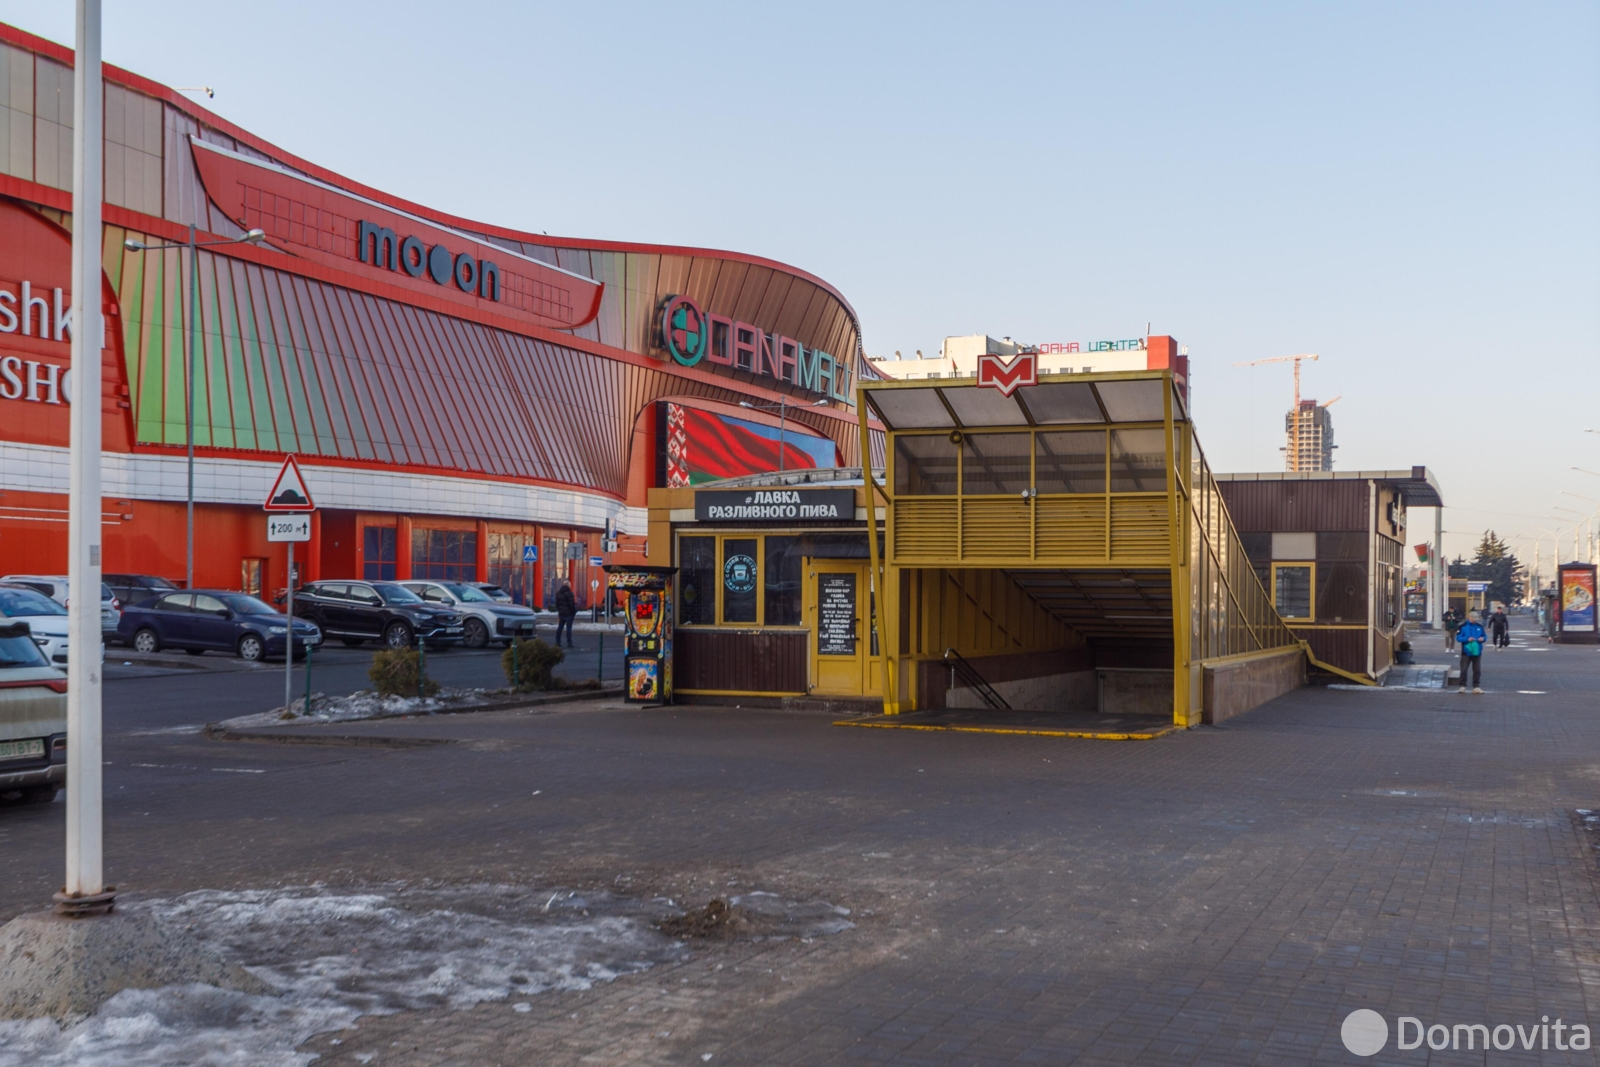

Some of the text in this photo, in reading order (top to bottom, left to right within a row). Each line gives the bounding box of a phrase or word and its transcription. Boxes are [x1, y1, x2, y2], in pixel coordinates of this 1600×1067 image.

[0, 280, 105, 349] shk
[1039, 339, 1139, 354] ДАНА ЦЕНТР
[708, 504, 838, 519] РАЗЛИВНОГО ПИВА
[277, 523, 294, 534] 200
